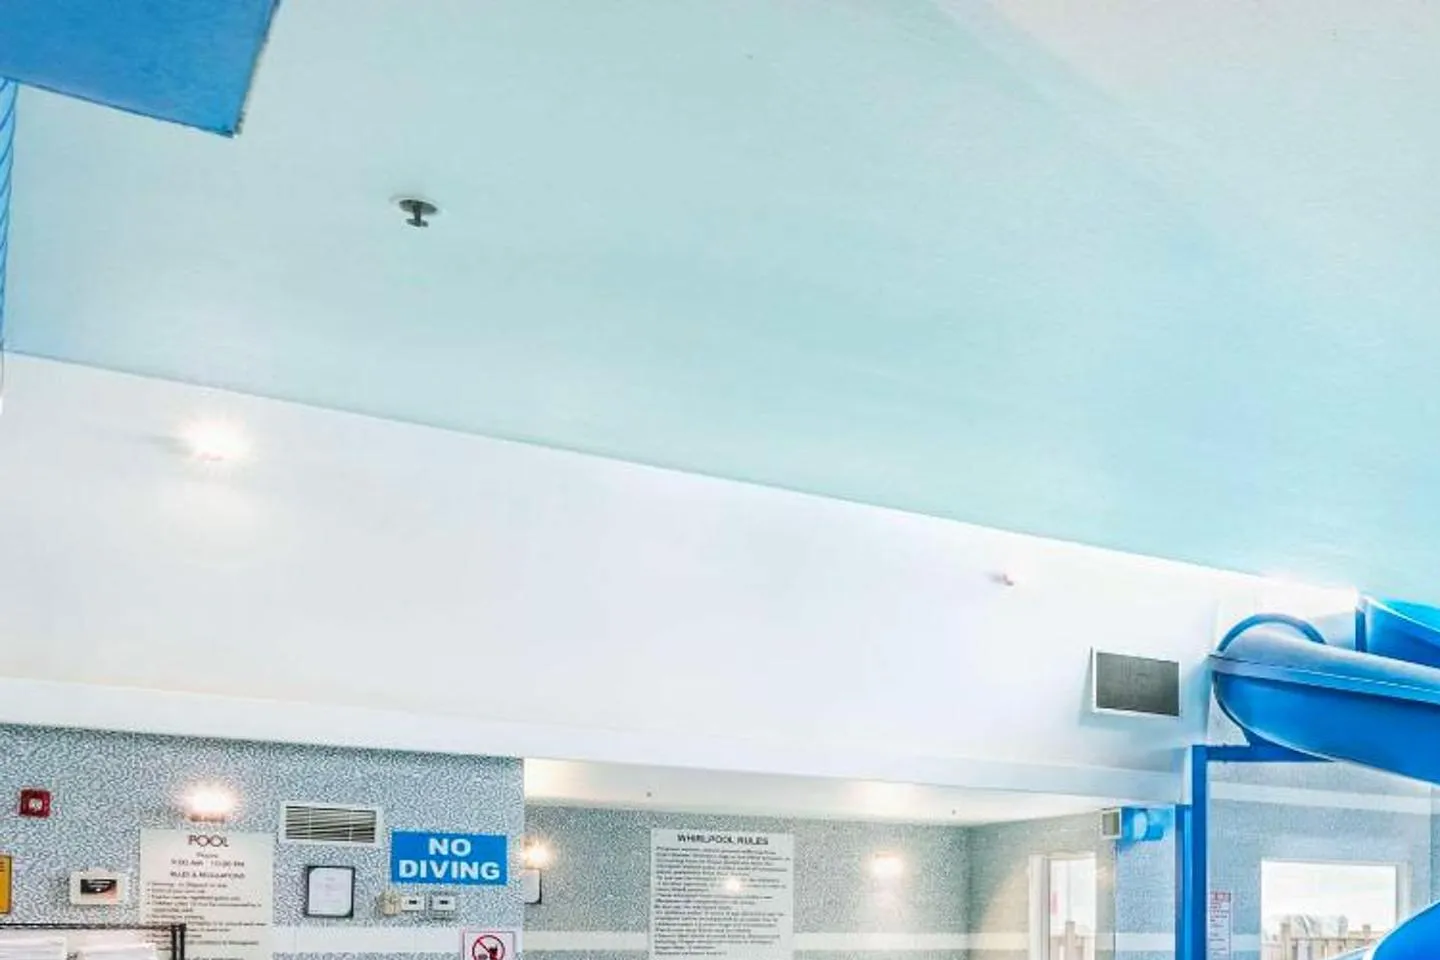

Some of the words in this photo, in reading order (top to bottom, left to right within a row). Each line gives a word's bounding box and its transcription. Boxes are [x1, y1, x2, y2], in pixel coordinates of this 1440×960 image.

[187, 834, 229, 848] POOL
[428, 838, 472, 857] NO
[677, 834, 735, 844] WHIRLPOOL
[737, 836, 769, 846] RULES
[398, 859, 501, 880] DIVING
